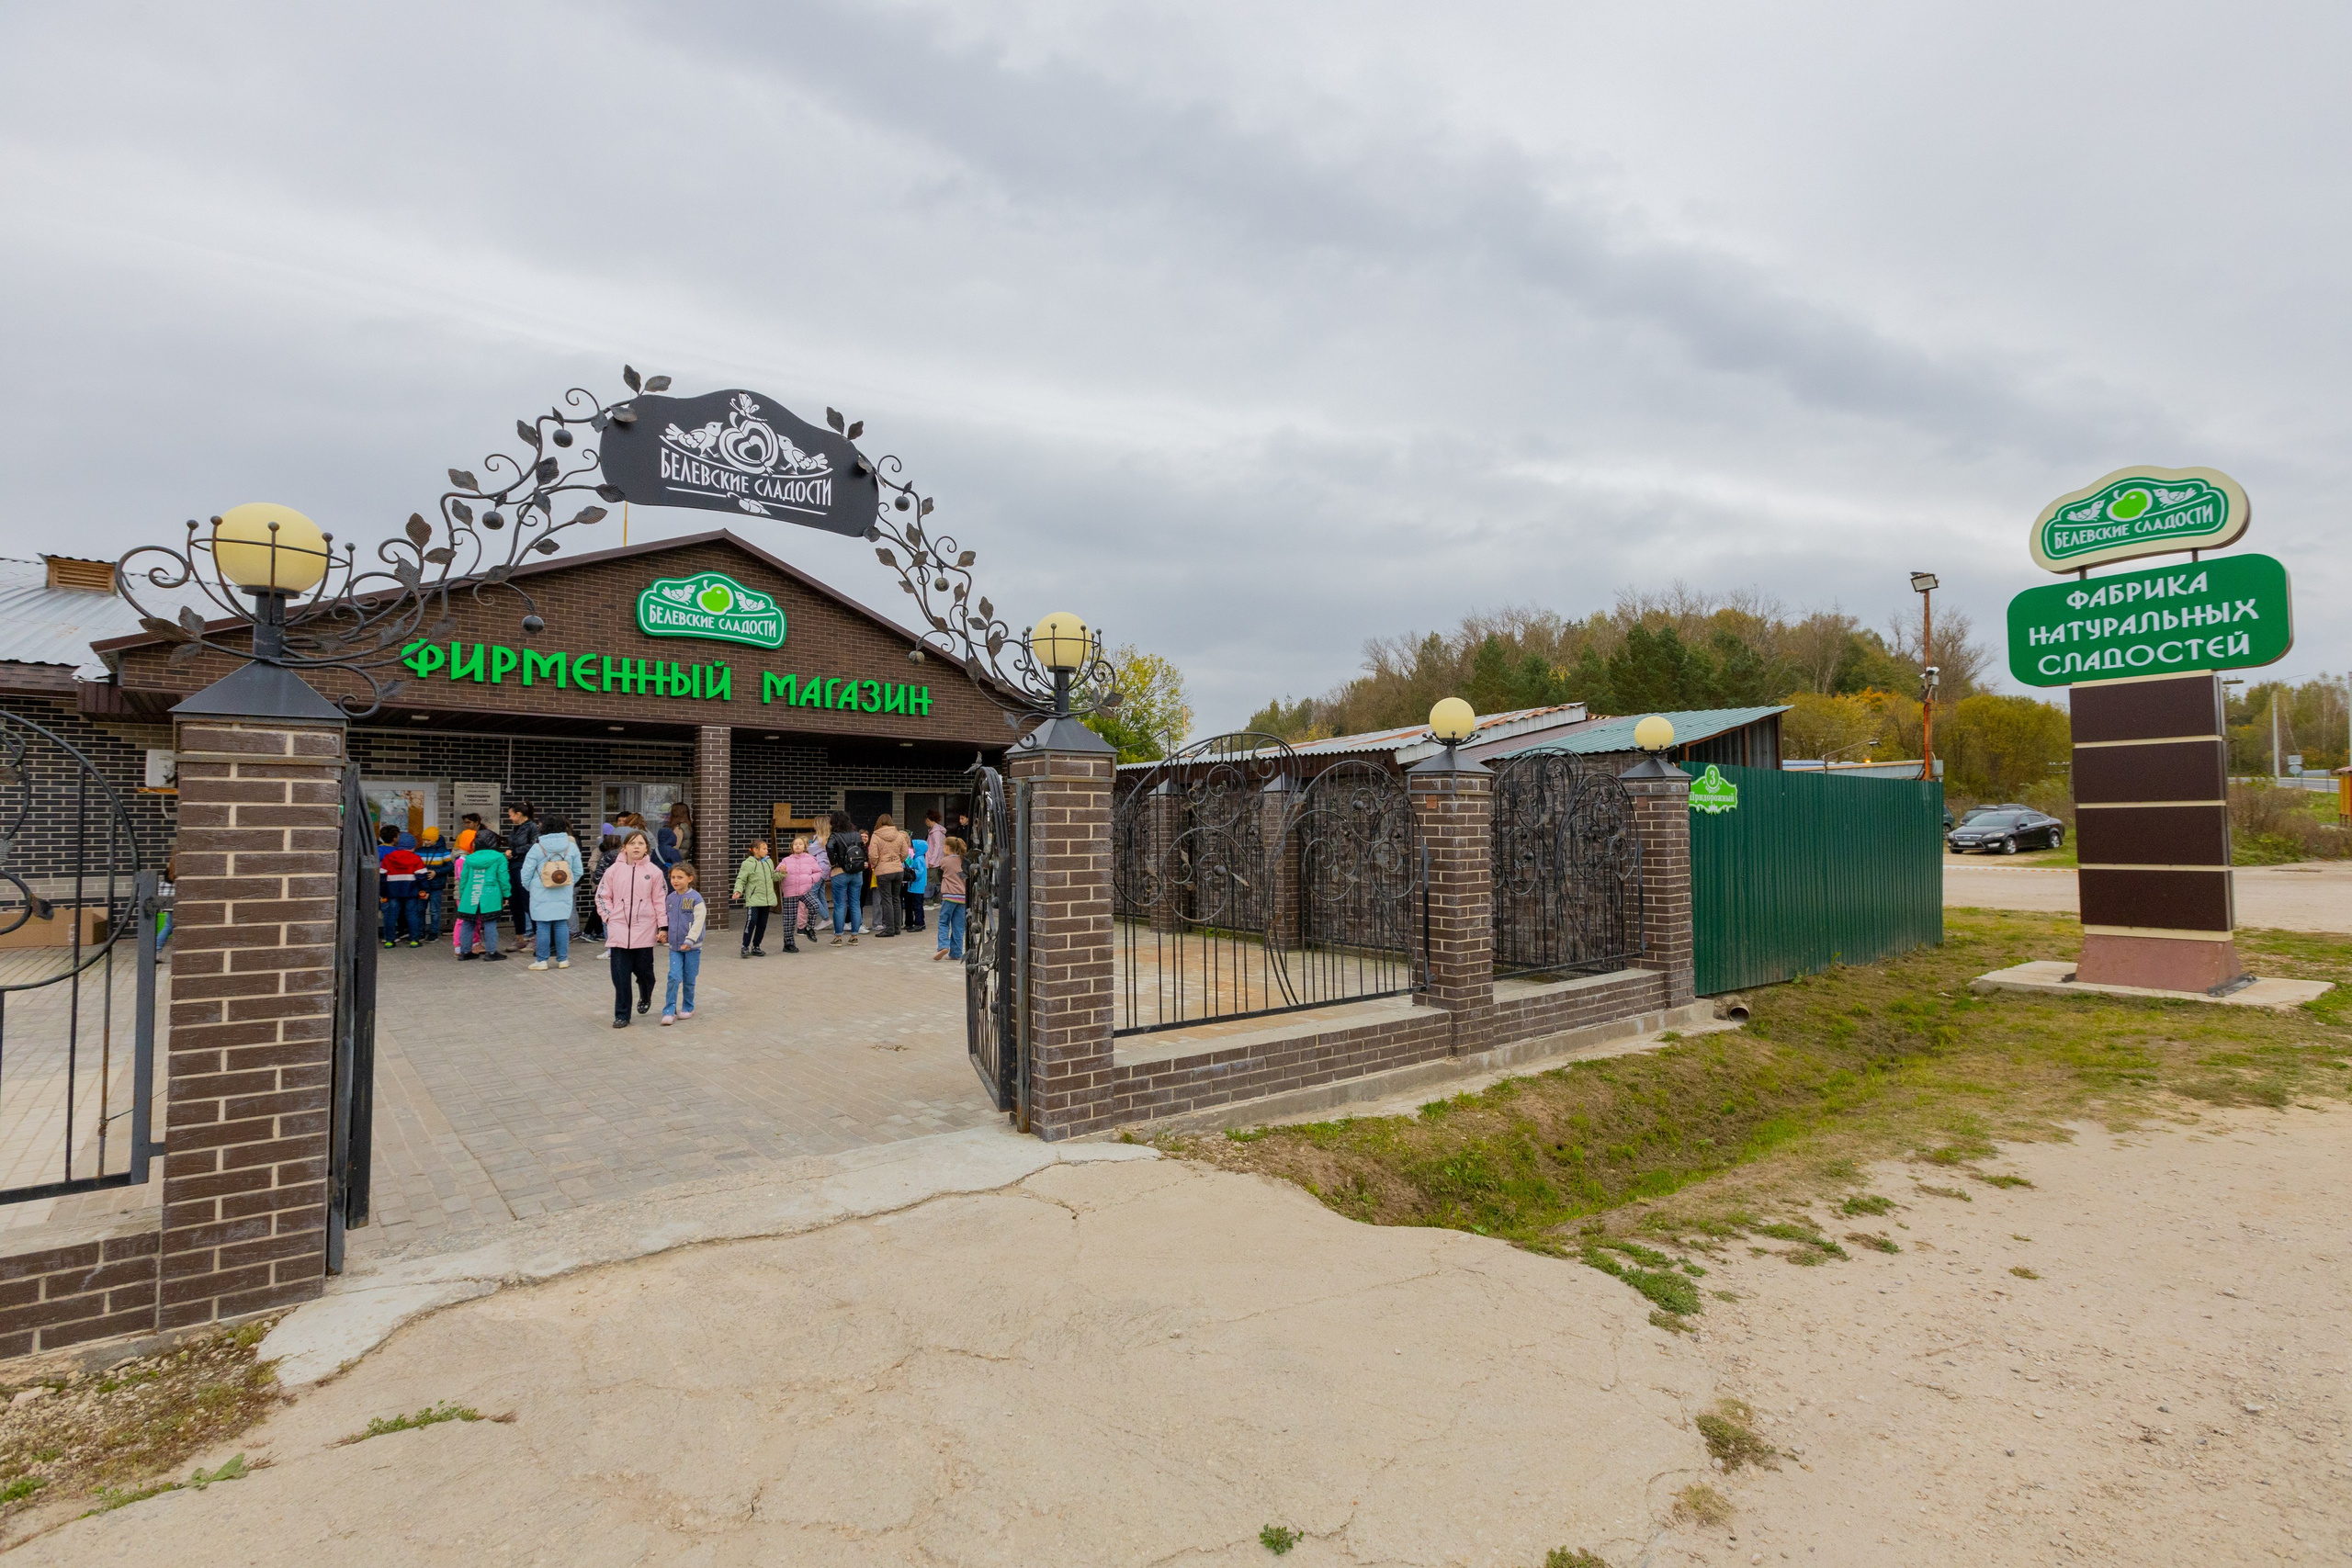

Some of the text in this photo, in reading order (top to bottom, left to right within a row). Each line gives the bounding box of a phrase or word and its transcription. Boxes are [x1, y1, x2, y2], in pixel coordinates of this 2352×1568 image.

[661, 446, 832, 507] БЕЛЕВСКИЕ СЛАДОСТИ
[2054, 503, 2214, 550] БЕЛЕВСКИЕ СЛАДОСТИ
[2066, 570, 2208, 610] ФАБРИКА
[649, 604, 777, 638] БЕЛЕВСКИЕ СЛАДОСТИ
[2029, 598, 2260, 647] НАТУРАЛЬНЫХ
[2037, 630, 2251, 676] СЛАДОСТЕЙ
[400, 637, 933, 716] ФИРМЕННЫЙ МАГАЗИН
[1690, 792, 1735, 804] Придорожный
[1709, 770, 1715, 785] 3
[681, 897, 695, 910] M
